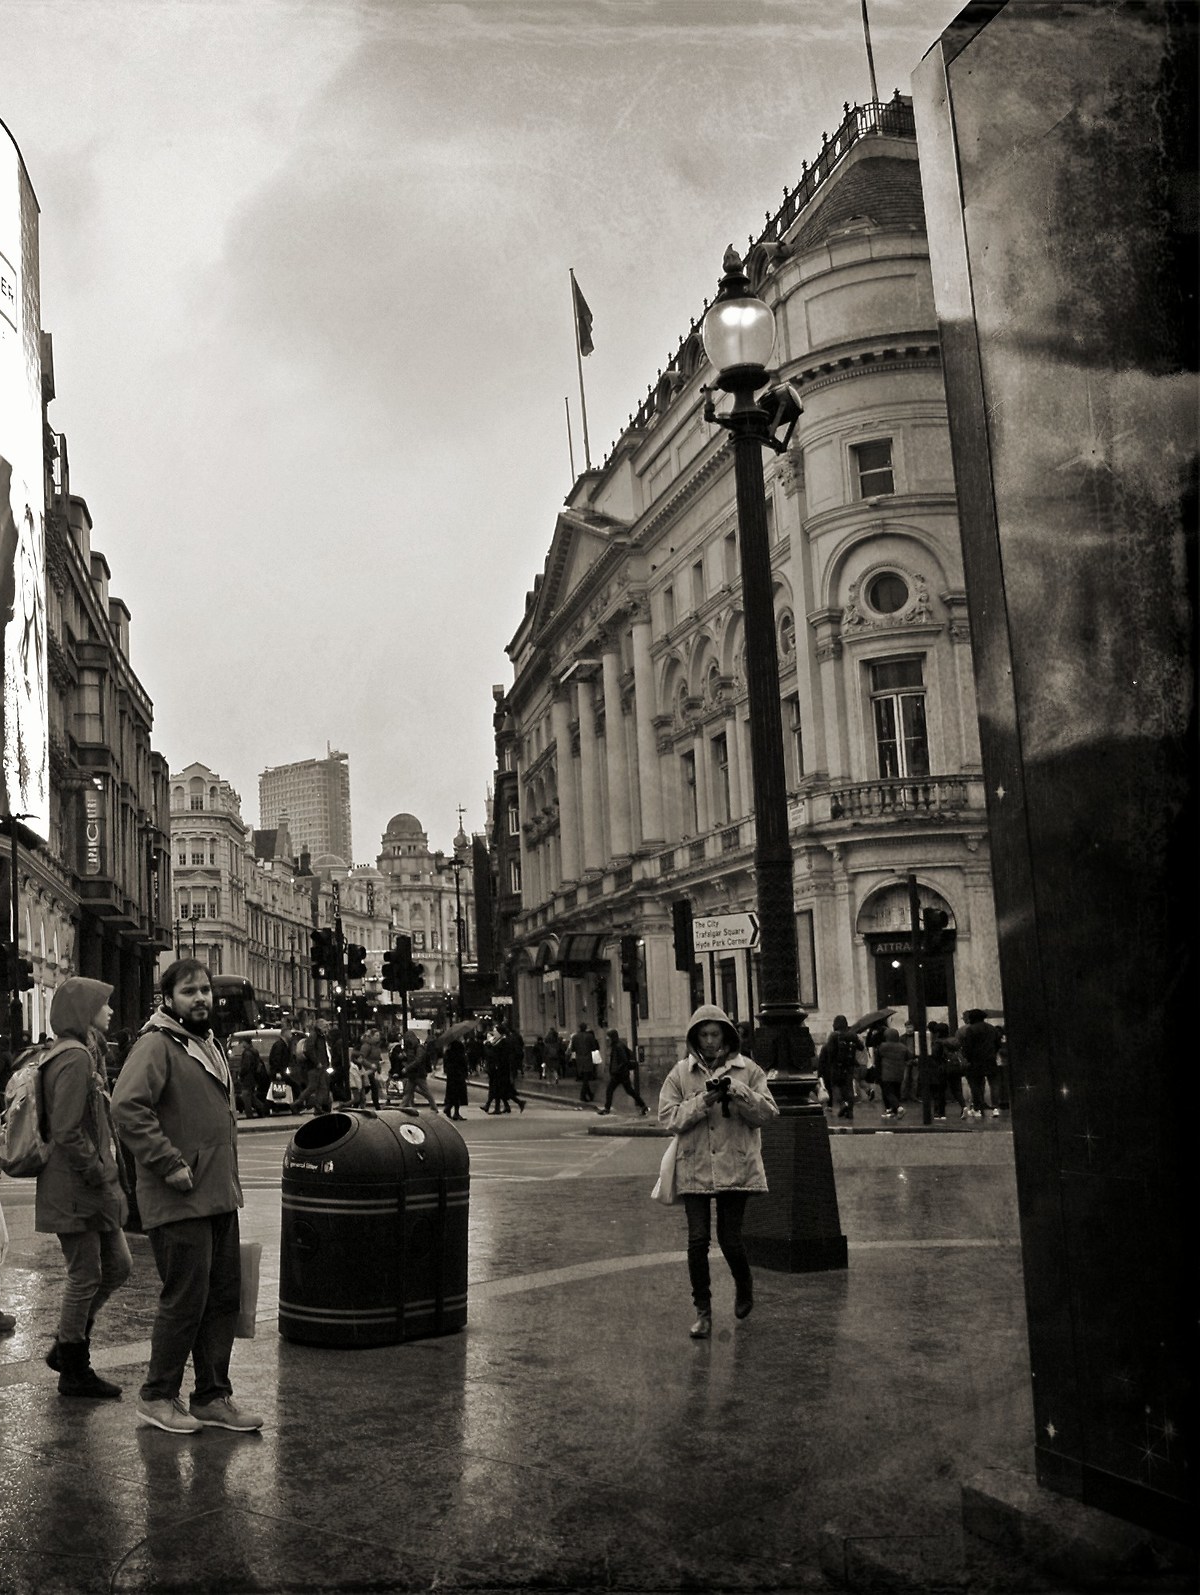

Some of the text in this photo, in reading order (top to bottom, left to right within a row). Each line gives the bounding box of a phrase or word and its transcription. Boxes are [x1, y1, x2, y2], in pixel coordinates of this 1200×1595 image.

[707, 920, 719, 928] City
[695, 928, 745, 938] Trafalgar Square
[696, 941, 710, 949] Hyde
[727, 938, 748, 946] Corner
[876, 942, 912, 952] ATTRA
